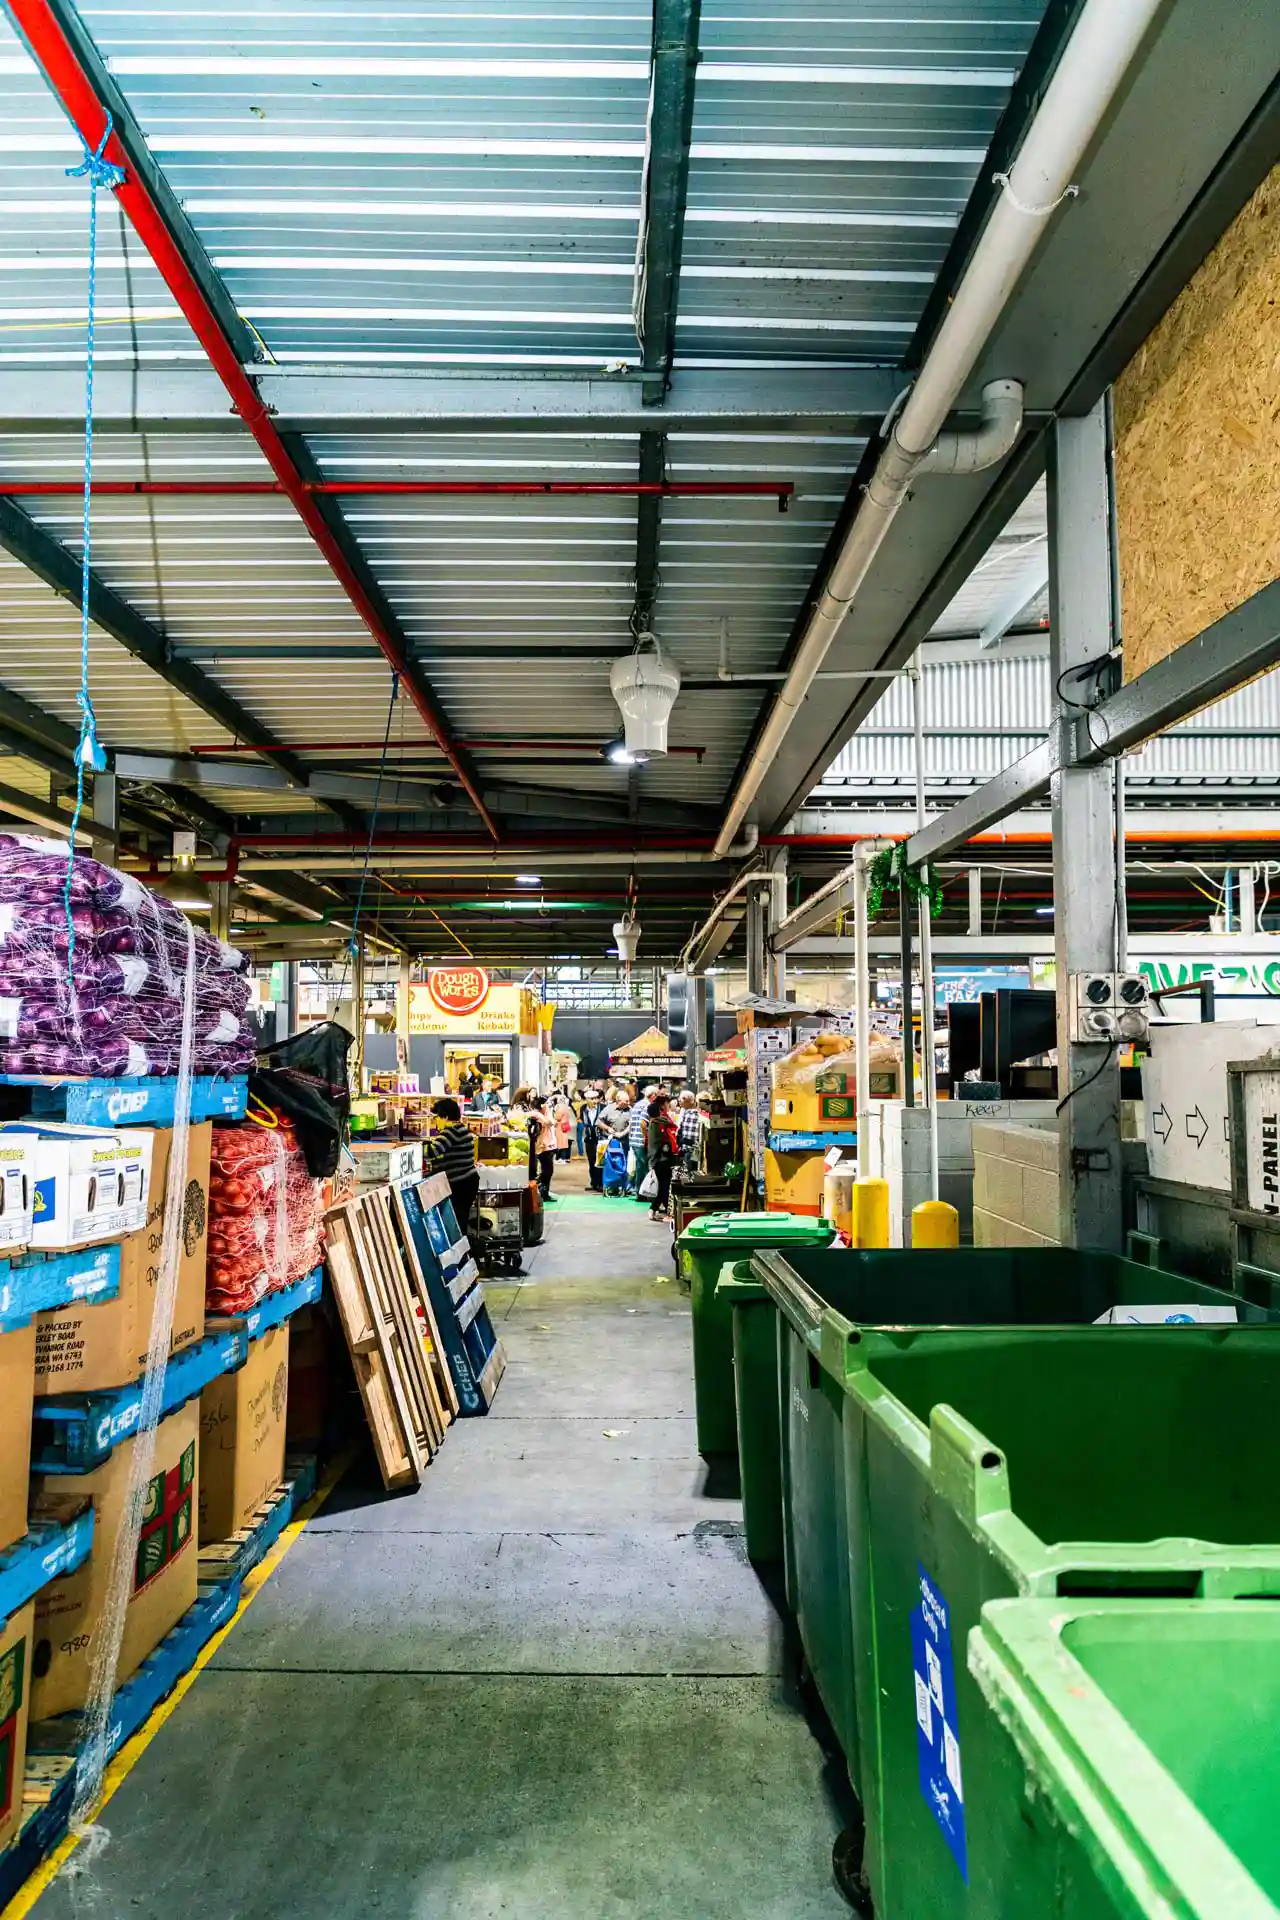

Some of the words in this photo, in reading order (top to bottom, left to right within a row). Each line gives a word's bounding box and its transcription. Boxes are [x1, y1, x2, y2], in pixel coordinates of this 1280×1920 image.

[438, 971, 479, 985] Dough
[480, 1011, 515, 1019] Drinks
[478, 1022, 515, 1030] Kebabs
[44, 1321, 71, 1331] PACKED
[72, 1320, 82, 1329] BY
[57, 1331, 76, 1341] BOAB
[66, 1340, 85, 1351] ROAD
[52, 1353, 63, 1362] WA
[64, 1351, 82, 1361] 6743
[66, 1361, 83, 1371] 1774
[60, 1634, 91, 1657] 980
